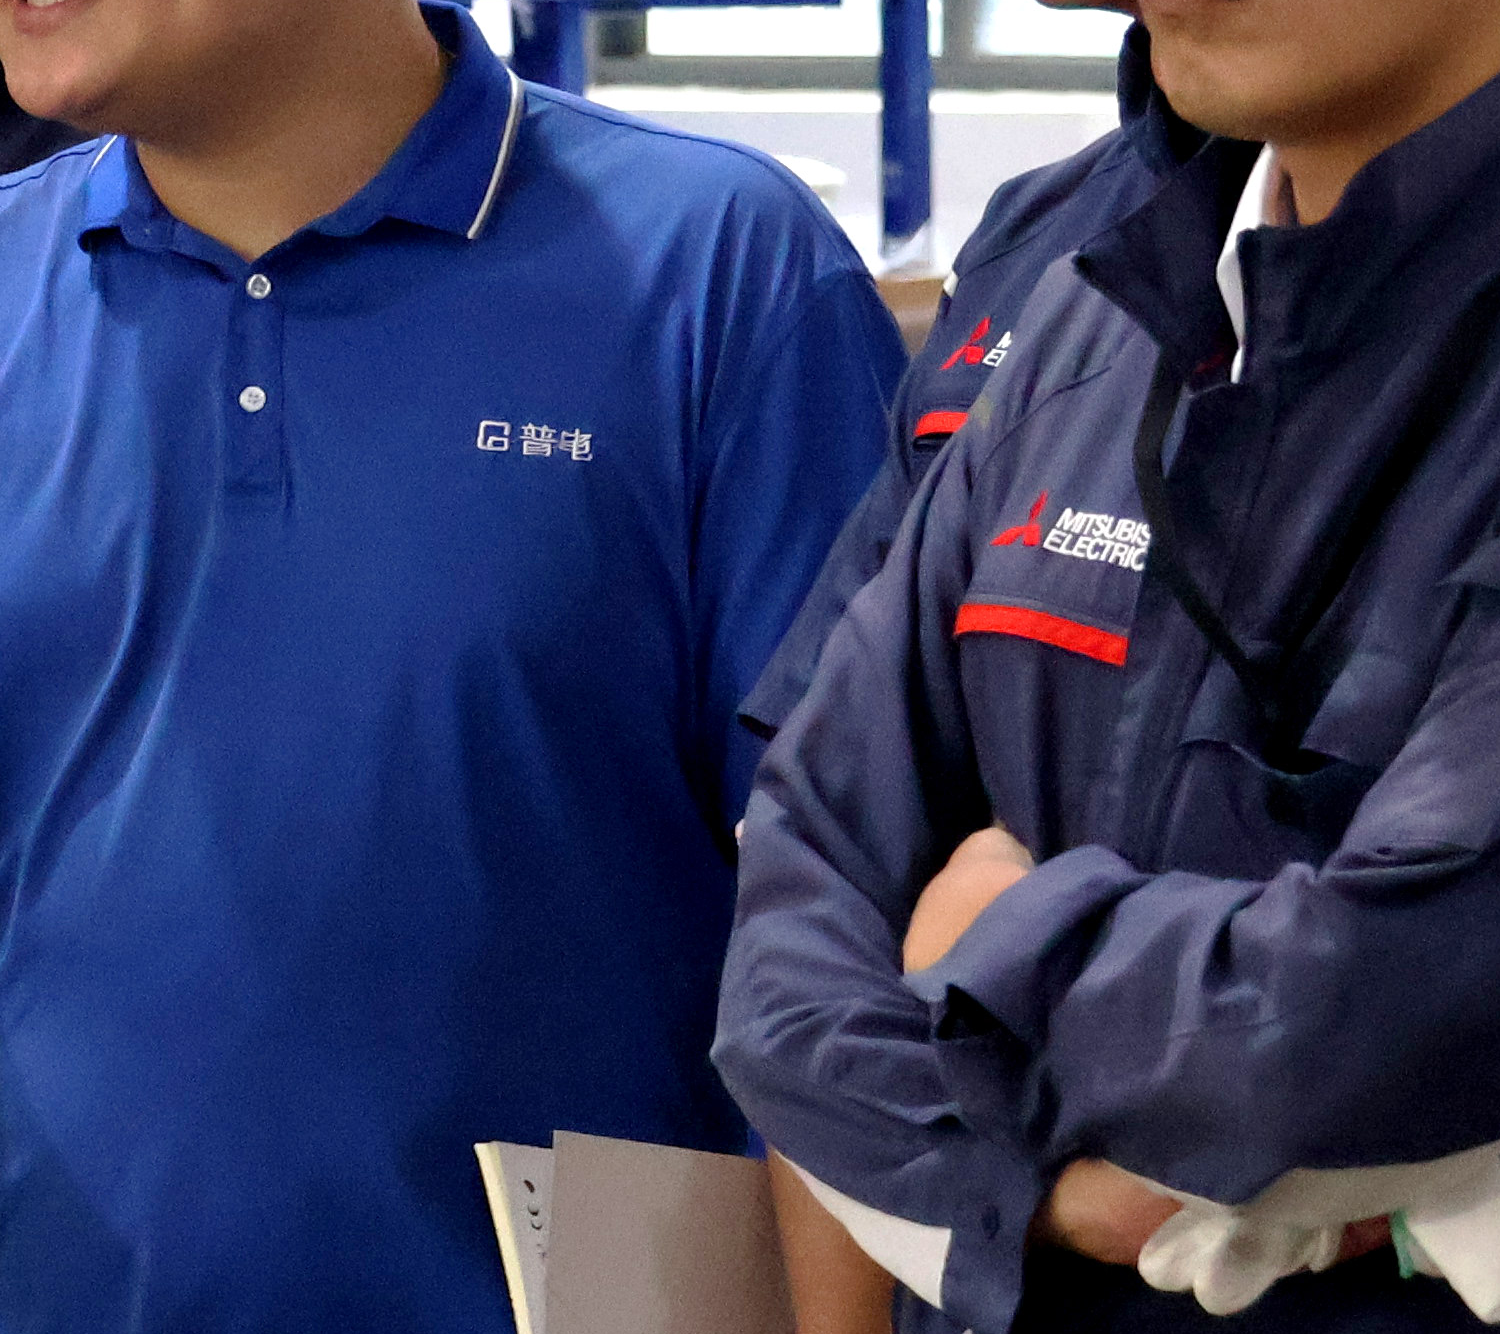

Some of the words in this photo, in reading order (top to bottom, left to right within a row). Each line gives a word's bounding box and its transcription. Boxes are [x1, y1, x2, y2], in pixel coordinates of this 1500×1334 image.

[518, 421, 594, 462] 普电
[1055, 507, 1152, 547] MITSUBIS
[1042, 528, 1147, 572] ELECTRIC
